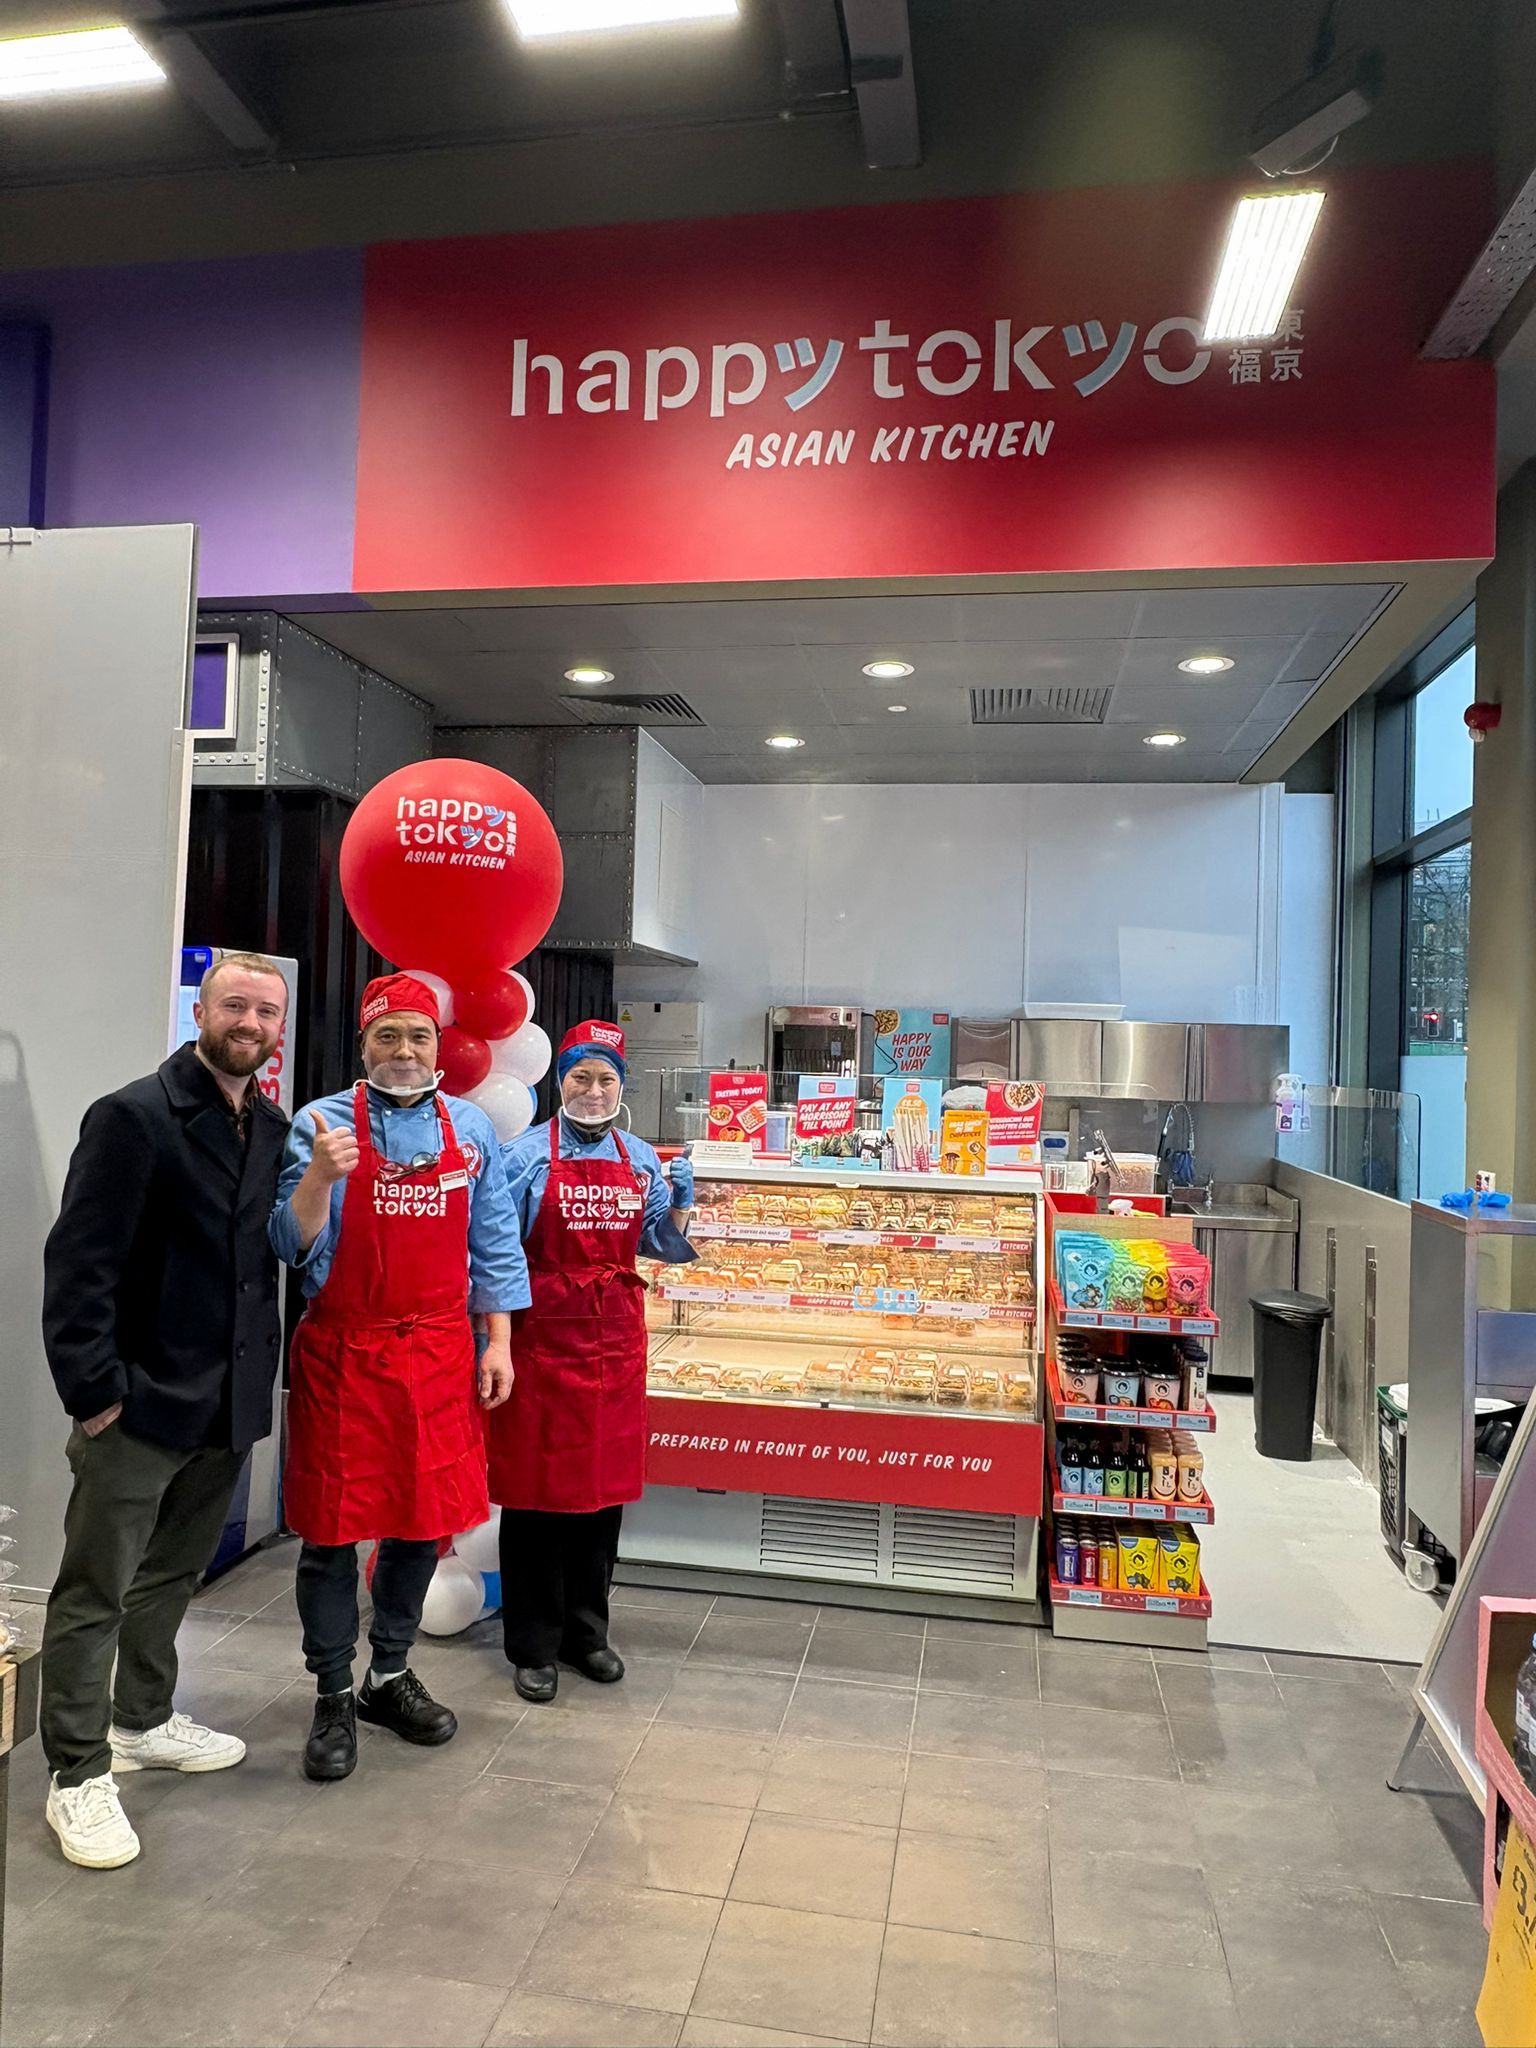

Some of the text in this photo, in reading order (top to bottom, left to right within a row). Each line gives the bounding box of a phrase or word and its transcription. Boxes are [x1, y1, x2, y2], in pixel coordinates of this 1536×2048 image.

[725, 421, 1055, 470] ASIAN KITCHEN
[404, 850, 506, 870] ASIAN KITCHEN
[892, 1033, 932, 1046] HAPPY
[893, 1046, 932, 1058] IS OUR
[900, 1059, 927, 1072] WAY
[800, 1101, 852, 1113] PAY AT ANY
[800, 1110, 851, 1121] MORRISONS
[802, 1118, 848, 1130] TILL POINT
[566, 1221, 630, 1231] ASIAN KITCHEN
[650, 1432, 993, 1473] PREPARED IN FRONT OF YOU, JUST FOR YOU
